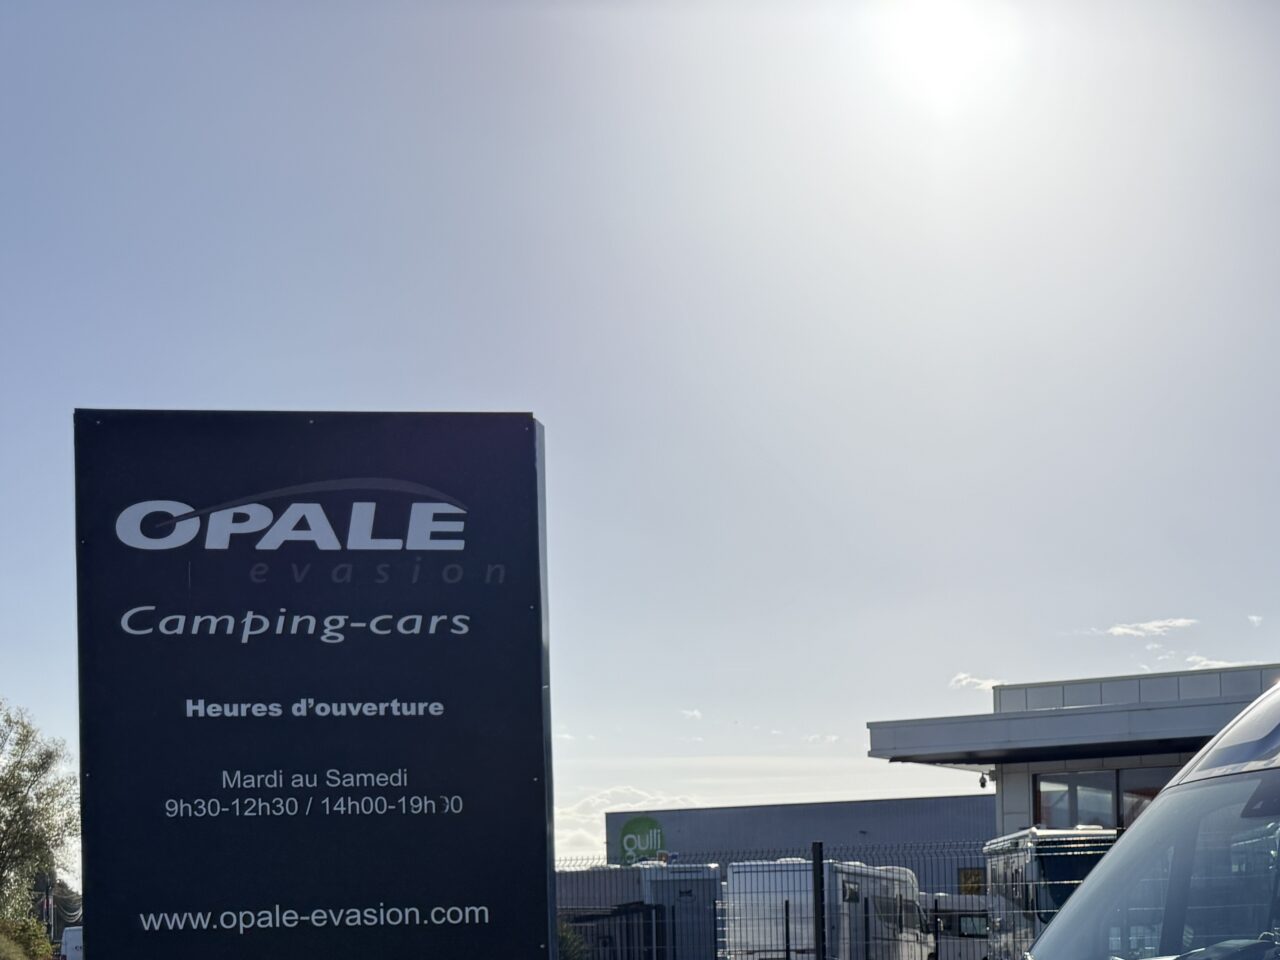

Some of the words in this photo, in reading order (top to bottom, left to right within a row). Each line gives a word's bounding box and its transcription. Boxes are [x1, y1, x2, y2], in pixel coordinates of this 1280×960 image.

[115, 499, 468, 551] OPALE
[249, 557, 506, 584] evasion
[119, 605, 471, 644] Camping-cars
[185, 699, 283, 718] Heures
[291, 698, 445, 718] d'ouverture
[221, 770, 283, 788] Mardi
[291, 773, 318, 788] au
[325, 768, 408, 787] Samedi
[164, 798, 299, 817] 9h30-12h30
[305, 797, 313, 816] /
[139, 901, 490, 934] www.opale-evasion.com
